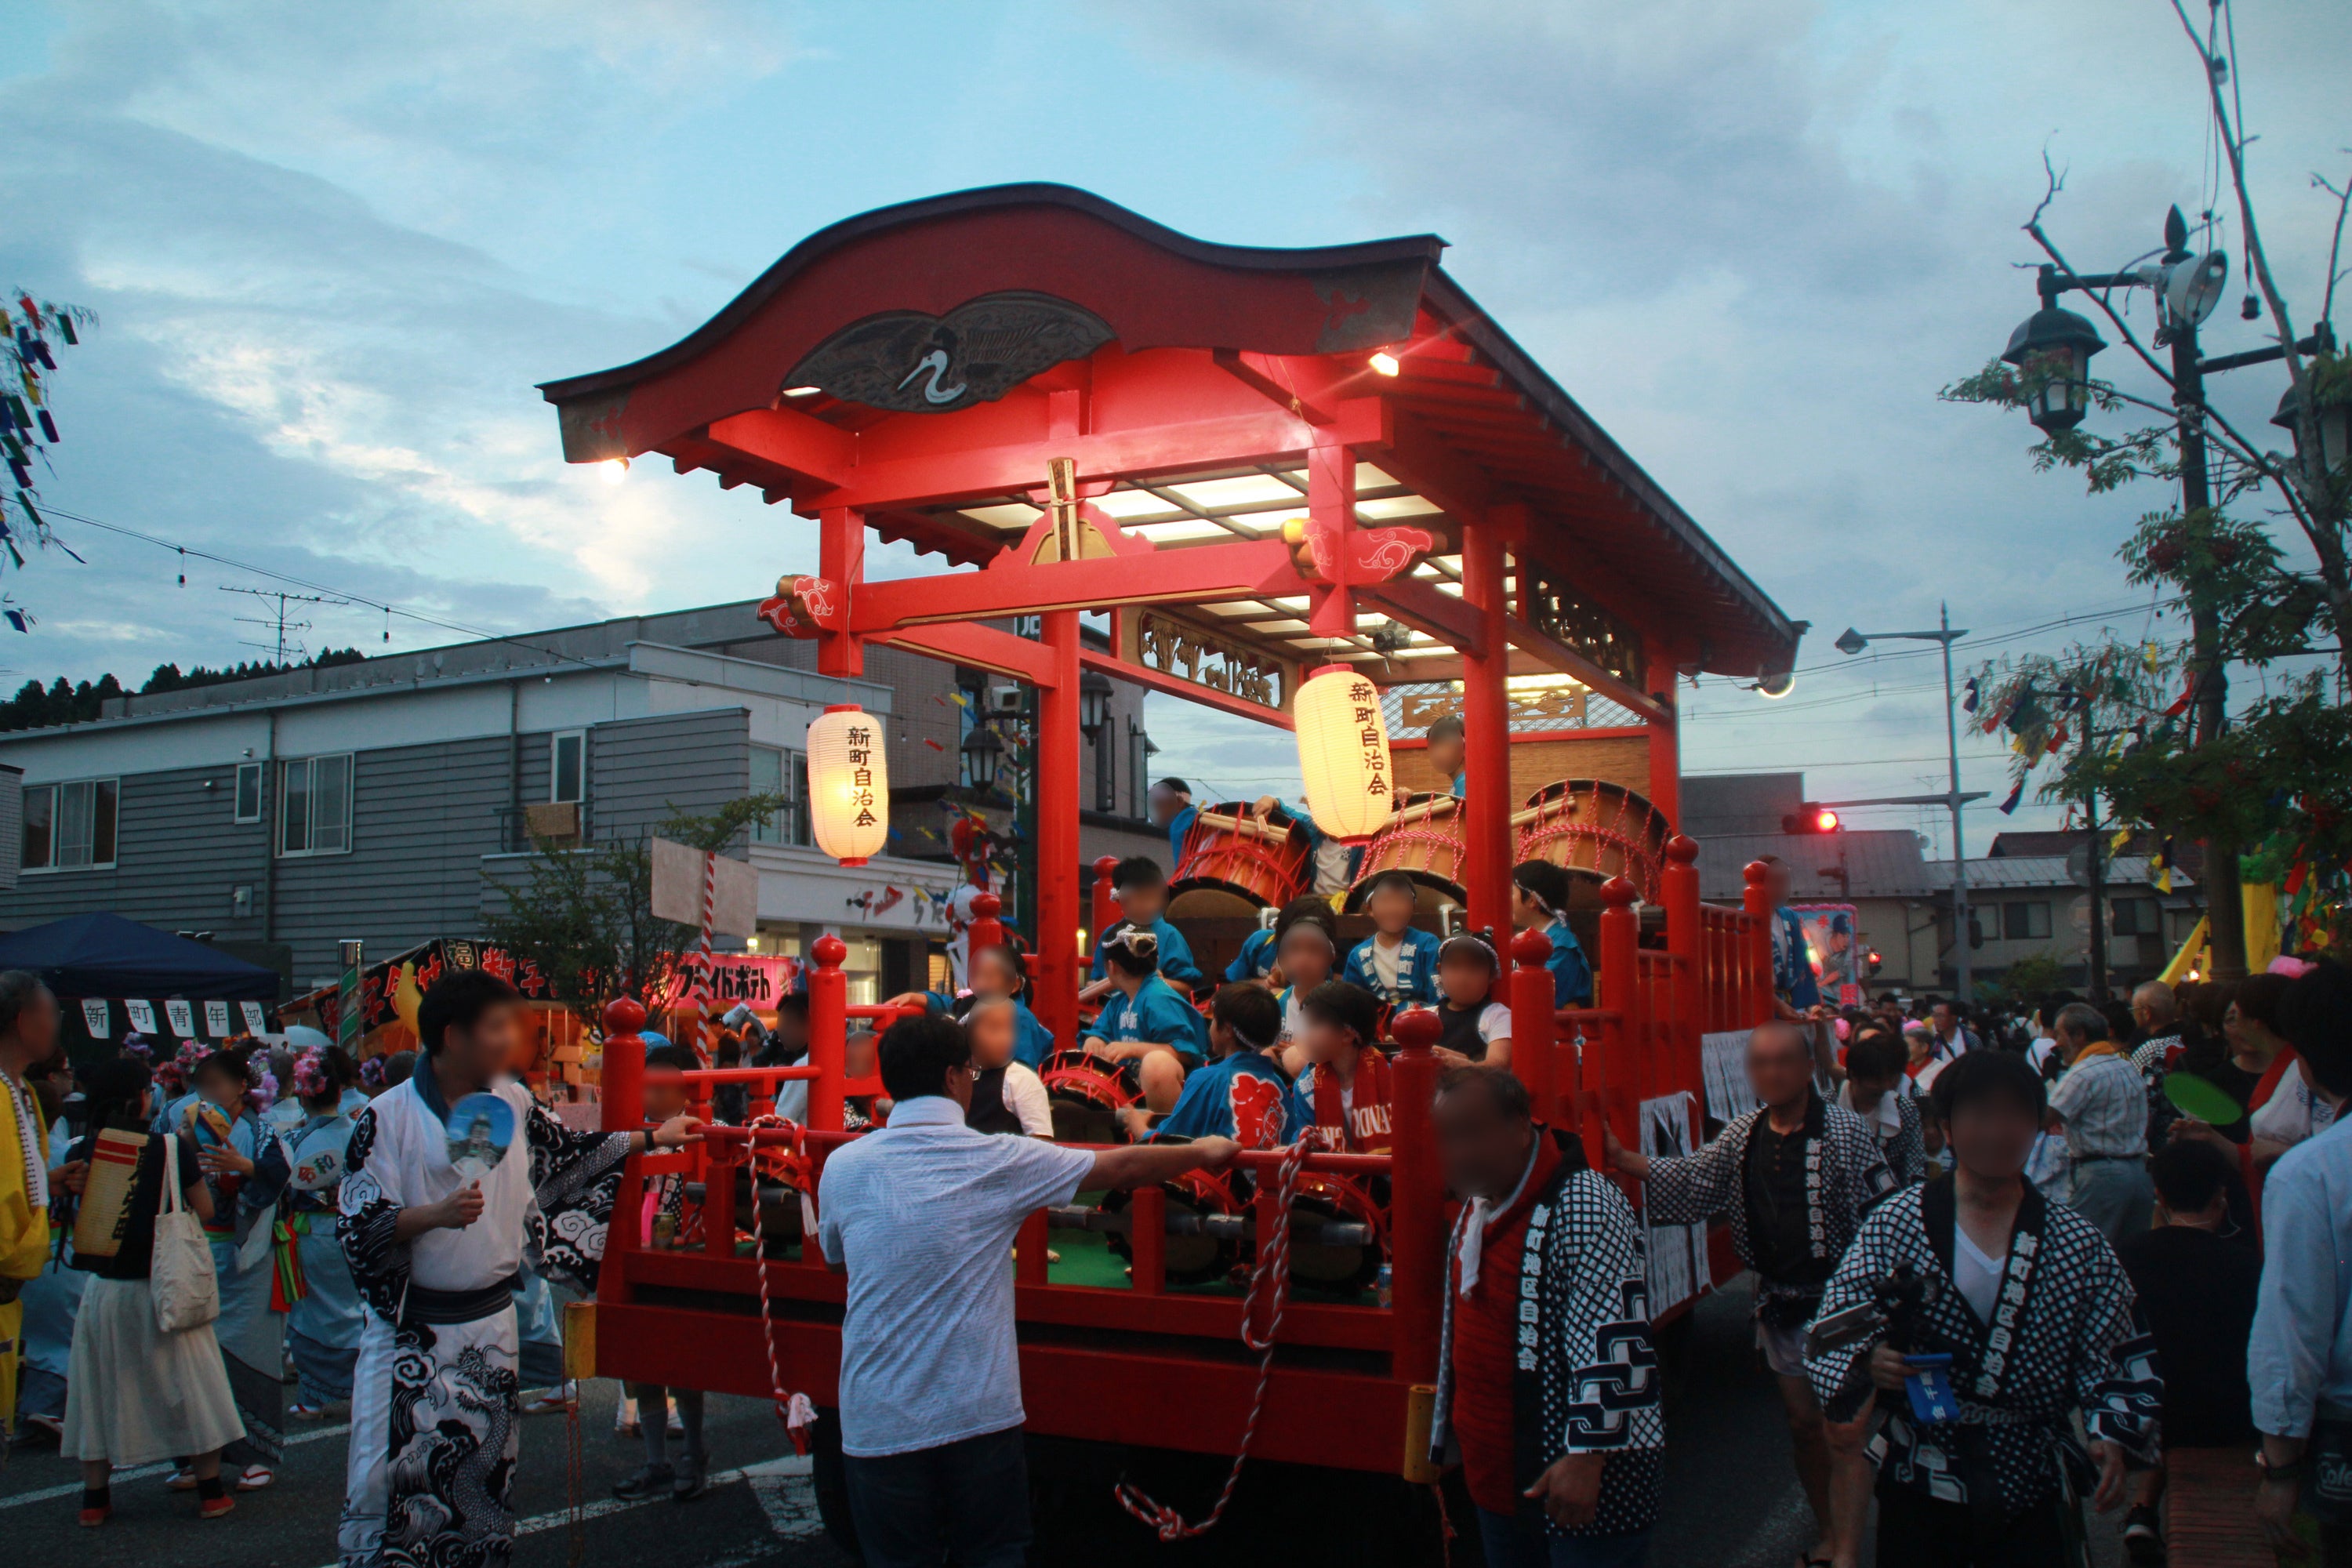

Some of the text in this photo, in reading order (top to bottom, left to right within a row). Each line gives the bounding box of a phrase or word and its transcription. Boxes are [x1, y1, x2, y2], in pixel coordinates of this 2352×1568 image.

[1348, 681, 1389, 797] 新町自治会
[846, 726, 878, 828] 新町自治会
[85, 1005, 262, 1029] 新町青年部
[298, 1154, 336, 1184] 令和
